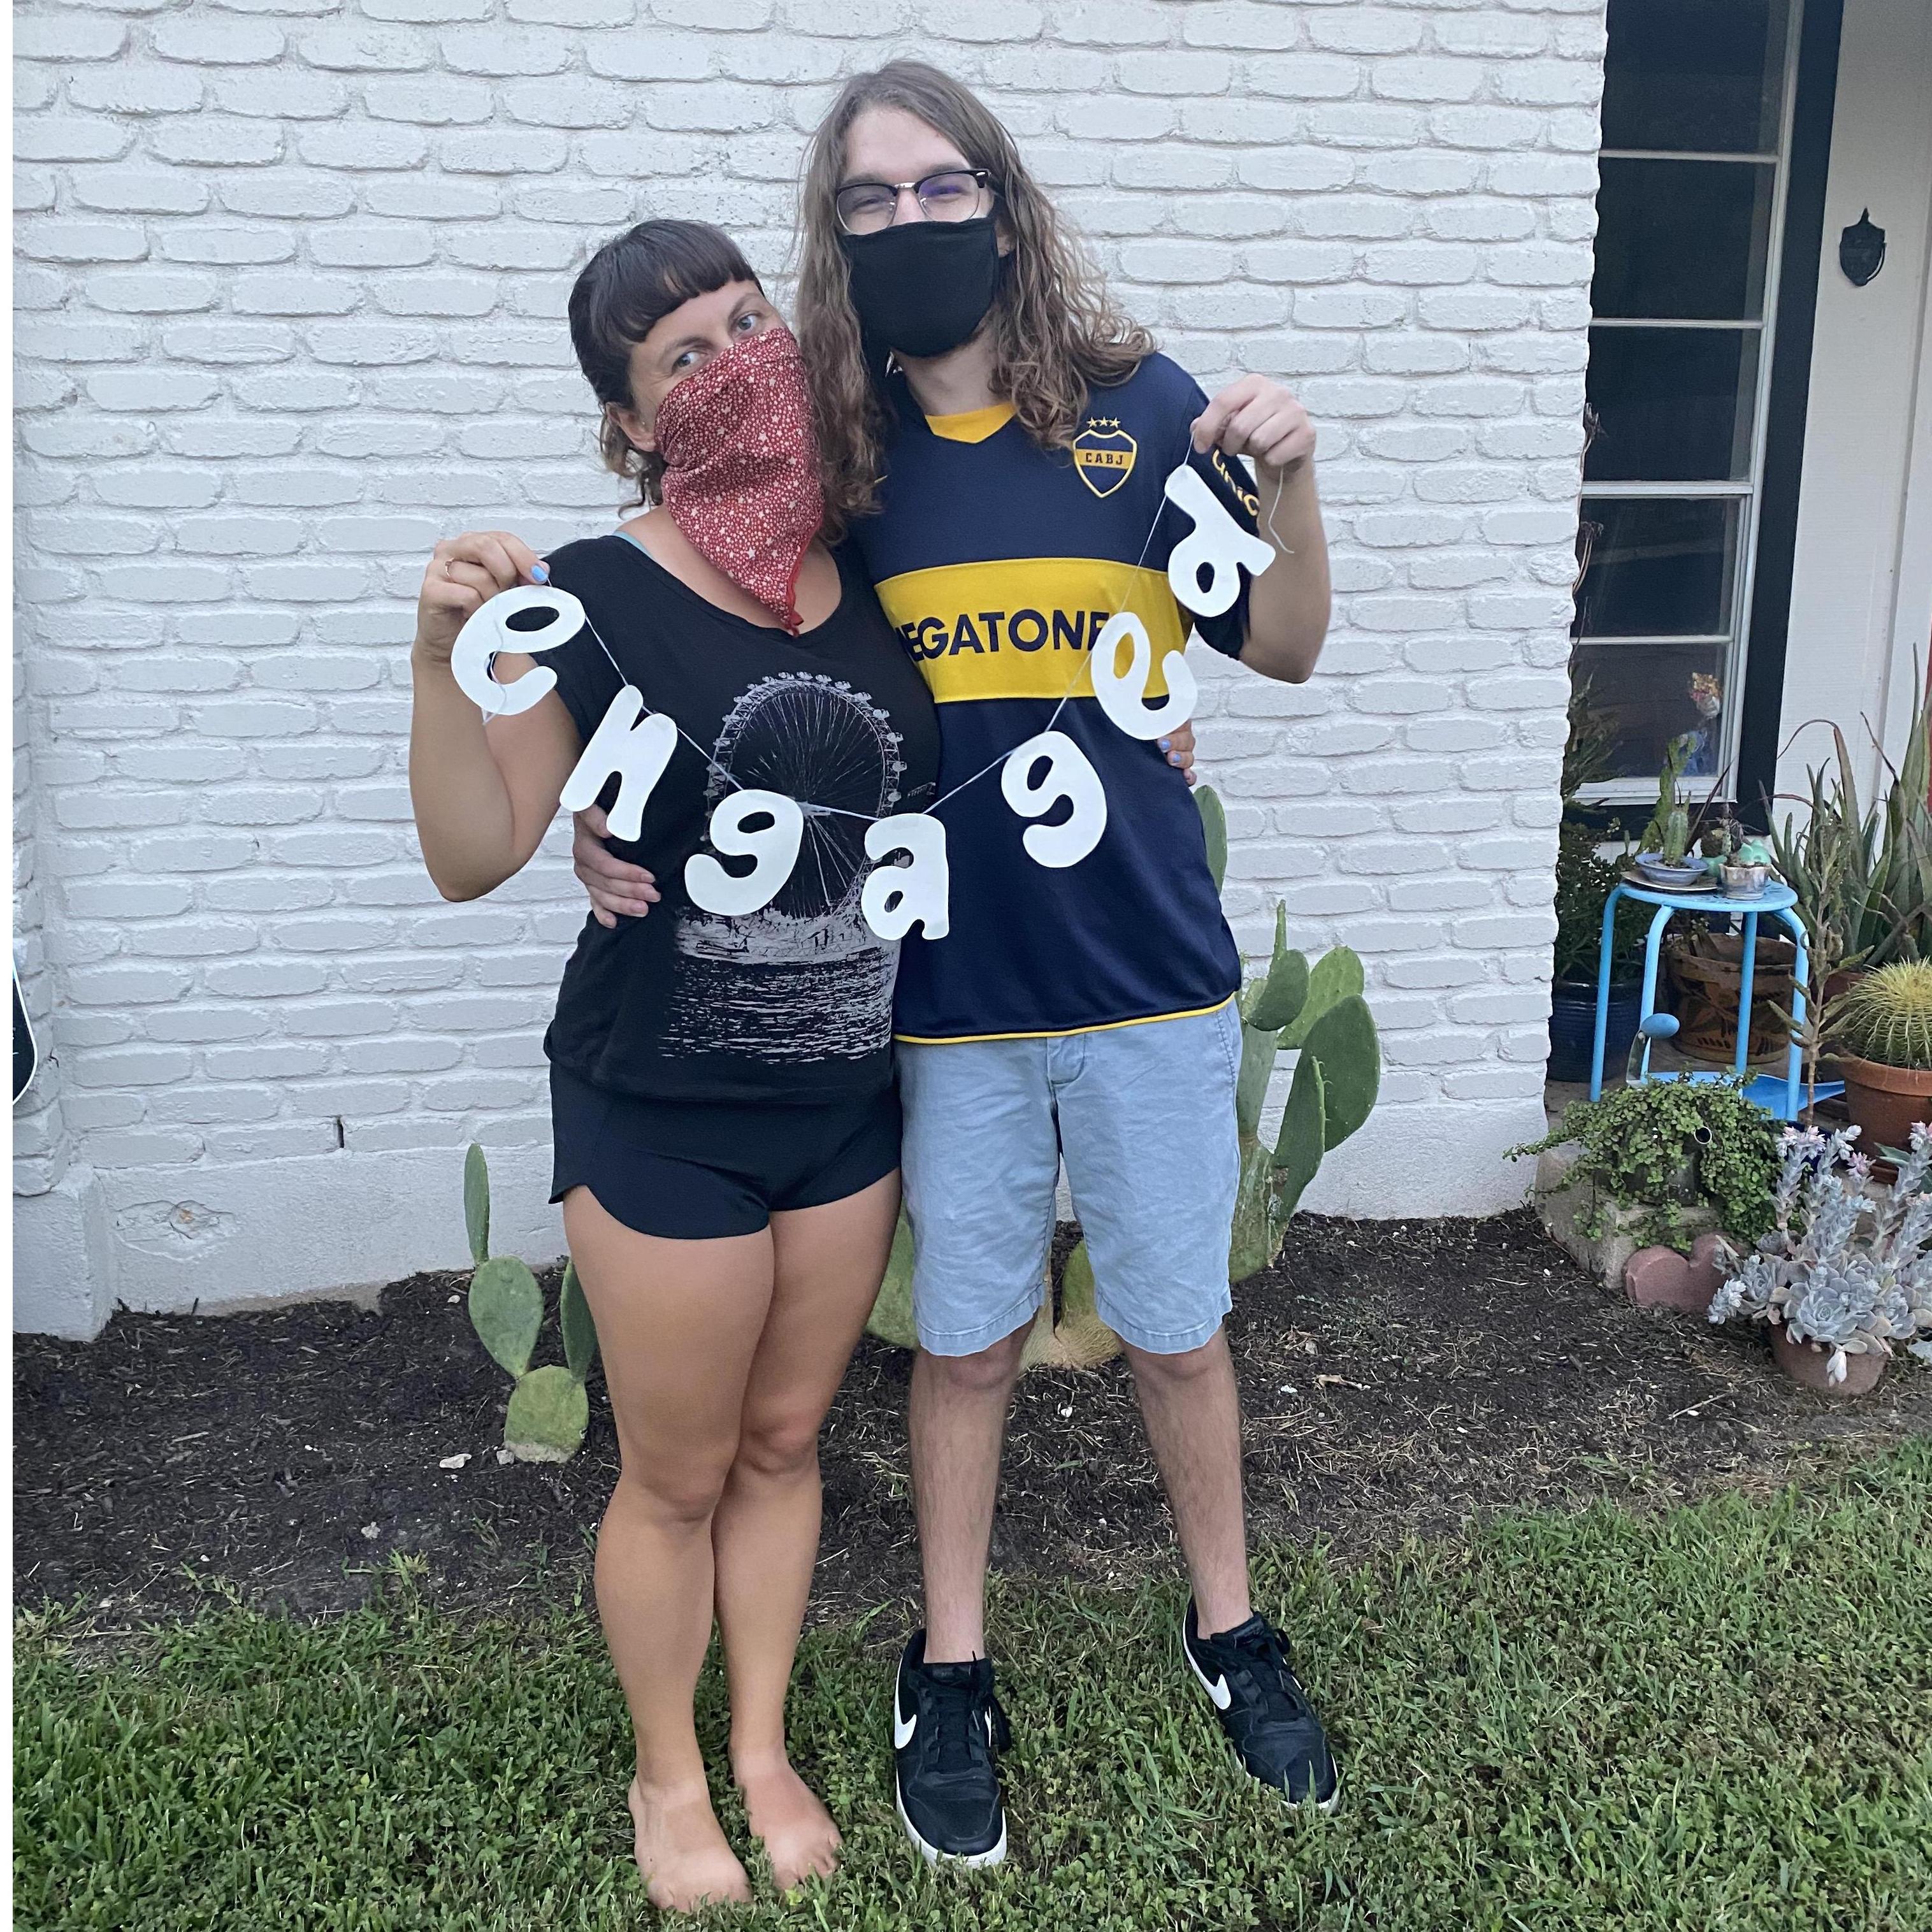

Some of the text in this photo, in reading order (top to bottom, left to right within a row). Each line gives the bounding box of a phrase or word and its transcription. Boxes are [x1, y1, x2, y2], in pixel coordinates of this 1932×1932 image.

[1085, 452, 1124, 465] CABJ
[895, 609, 1110, 661] EGATONE
[451, 463, 1276, 941] engaged
